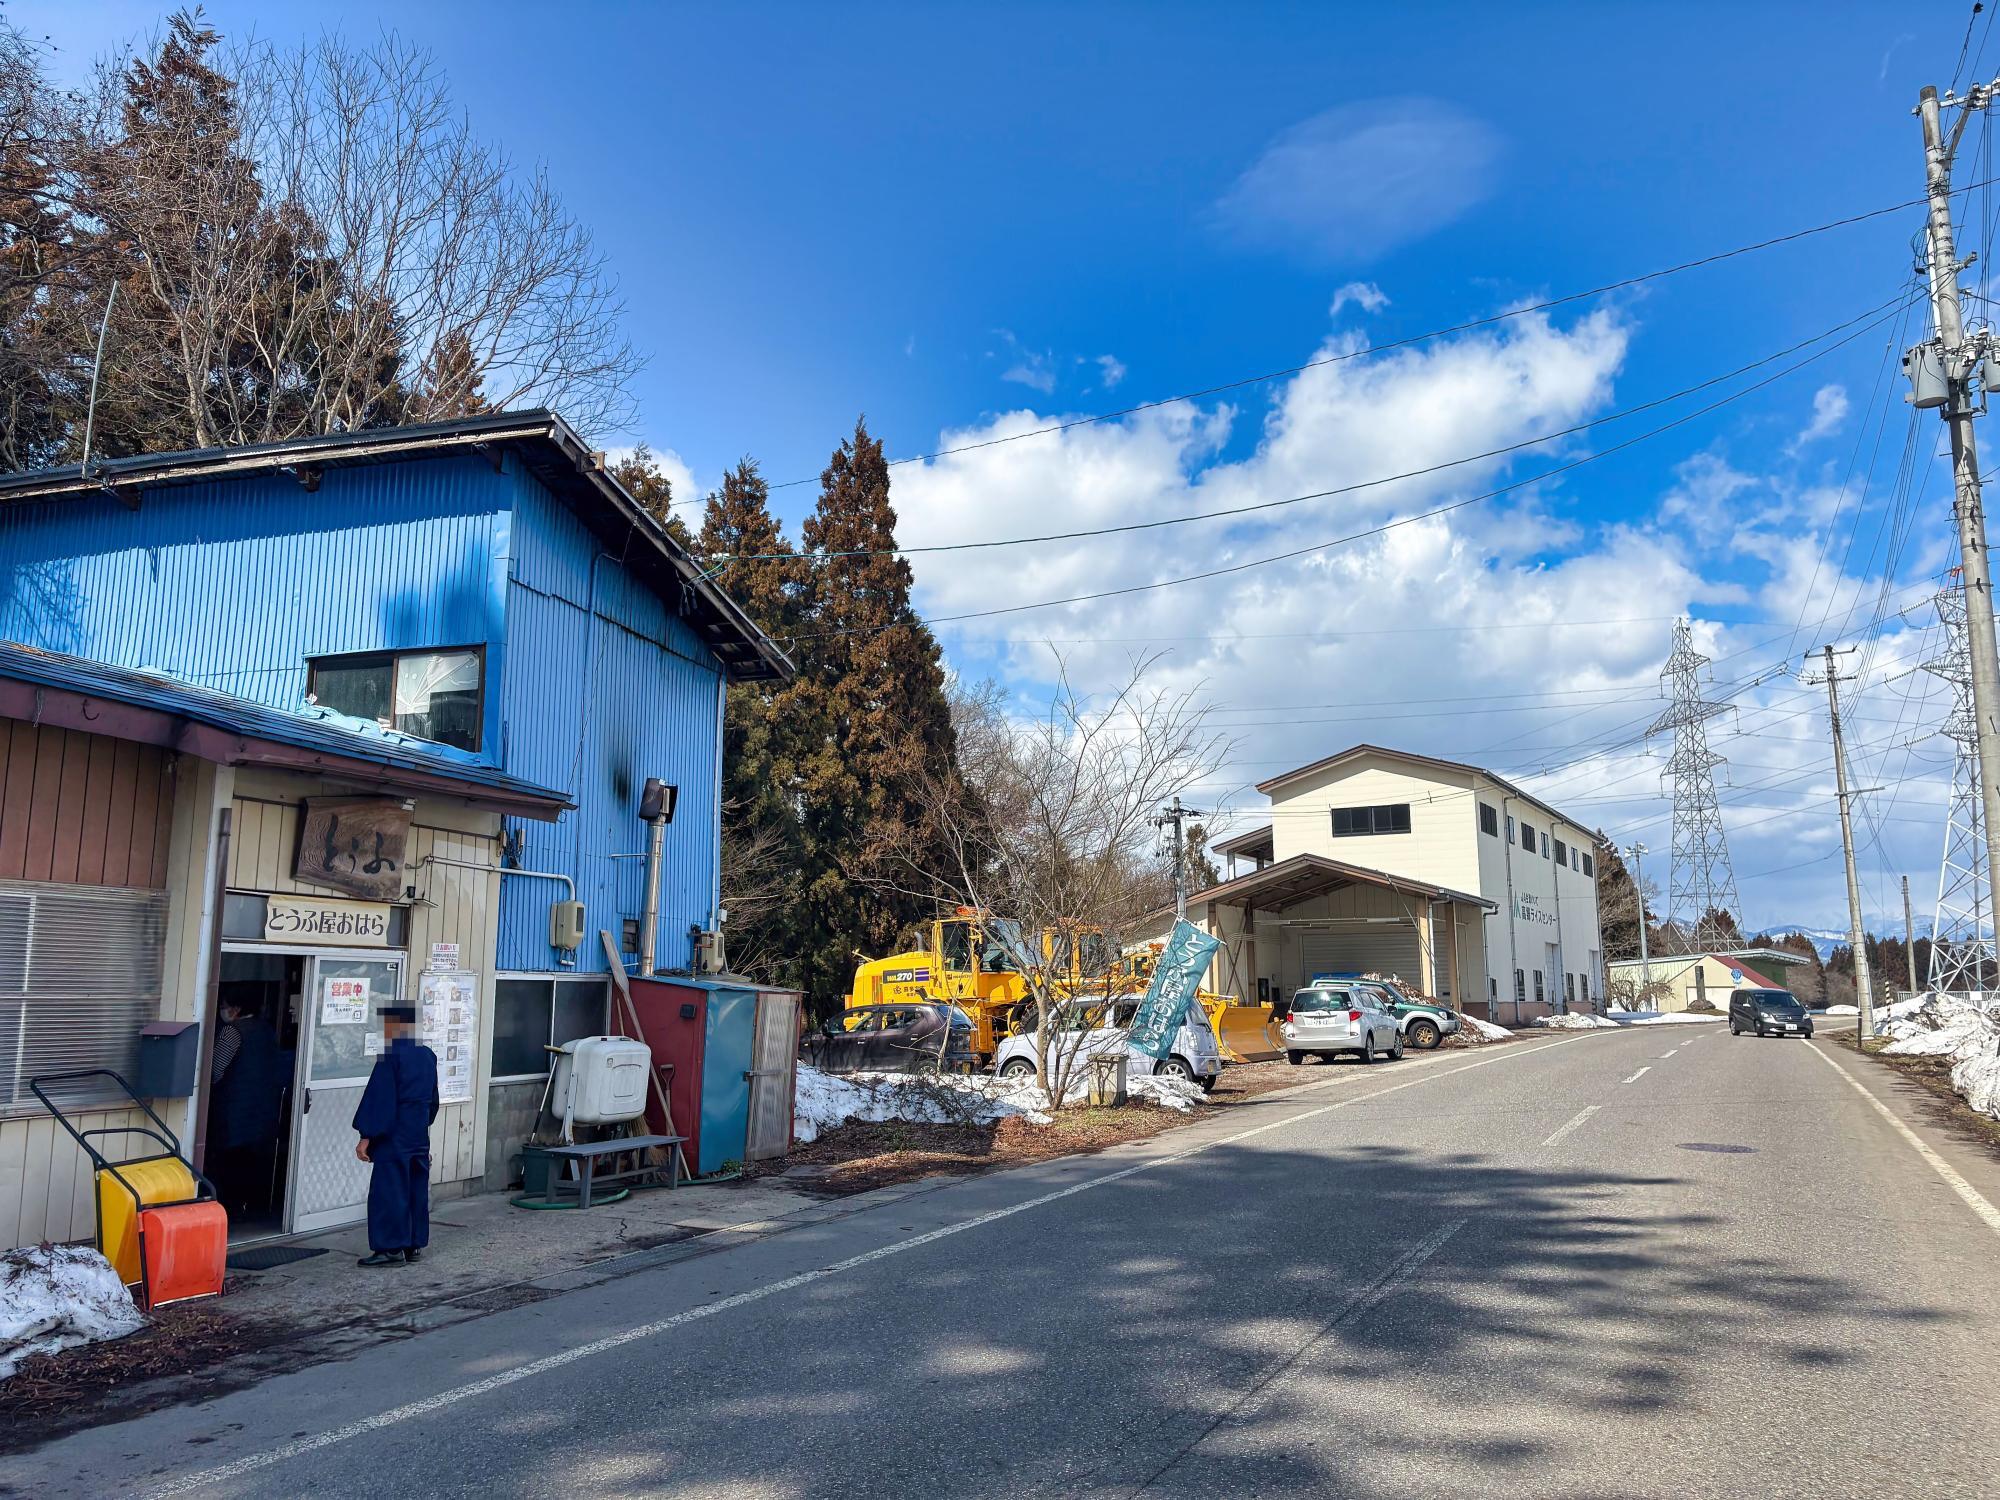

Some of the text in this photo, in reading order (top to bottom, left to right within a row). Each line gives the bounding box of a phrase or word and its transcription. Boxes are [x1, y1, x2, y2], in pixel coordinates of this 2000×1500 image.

[268, 907, 384, 936] とうふ屋おはら
[331, 981, 363, 997] 営業中
[1142, 933, 1205, 1052] とうふ屋おはら
